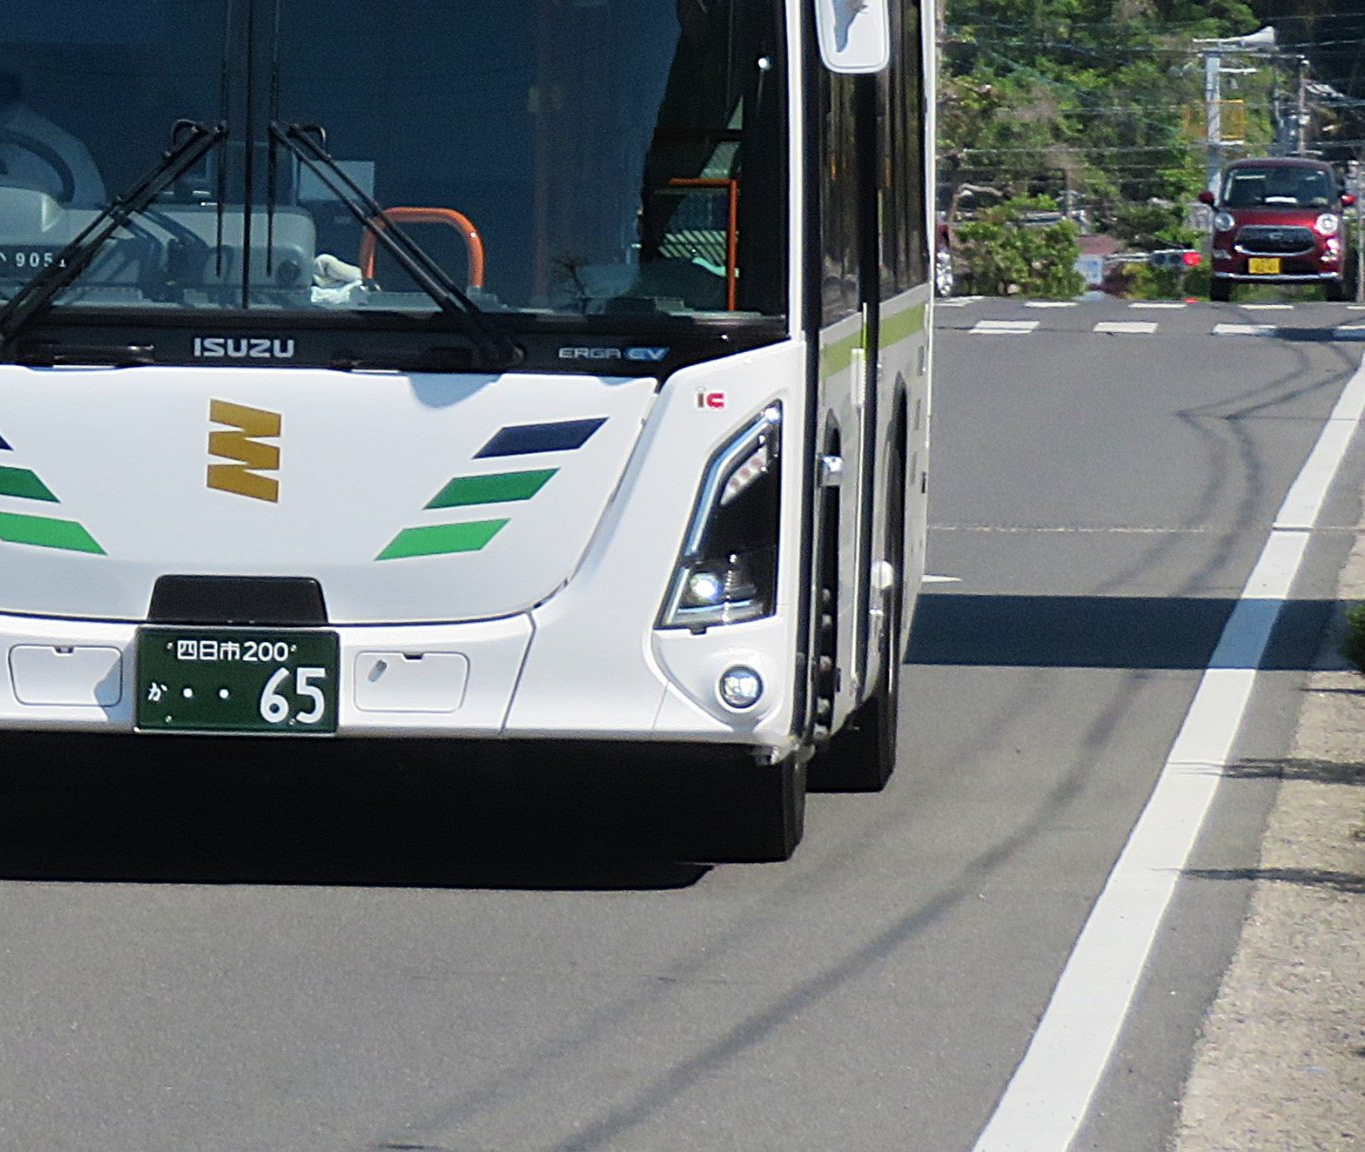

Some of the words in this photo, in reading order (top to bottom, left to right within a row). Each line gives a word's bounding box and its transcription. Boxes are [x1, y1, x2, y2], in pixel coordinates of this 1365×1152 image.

[193, 336, 295, 358] ISUZU
[558, 346, 622, 359] ERGA
[147, 682, 169, 702] か
